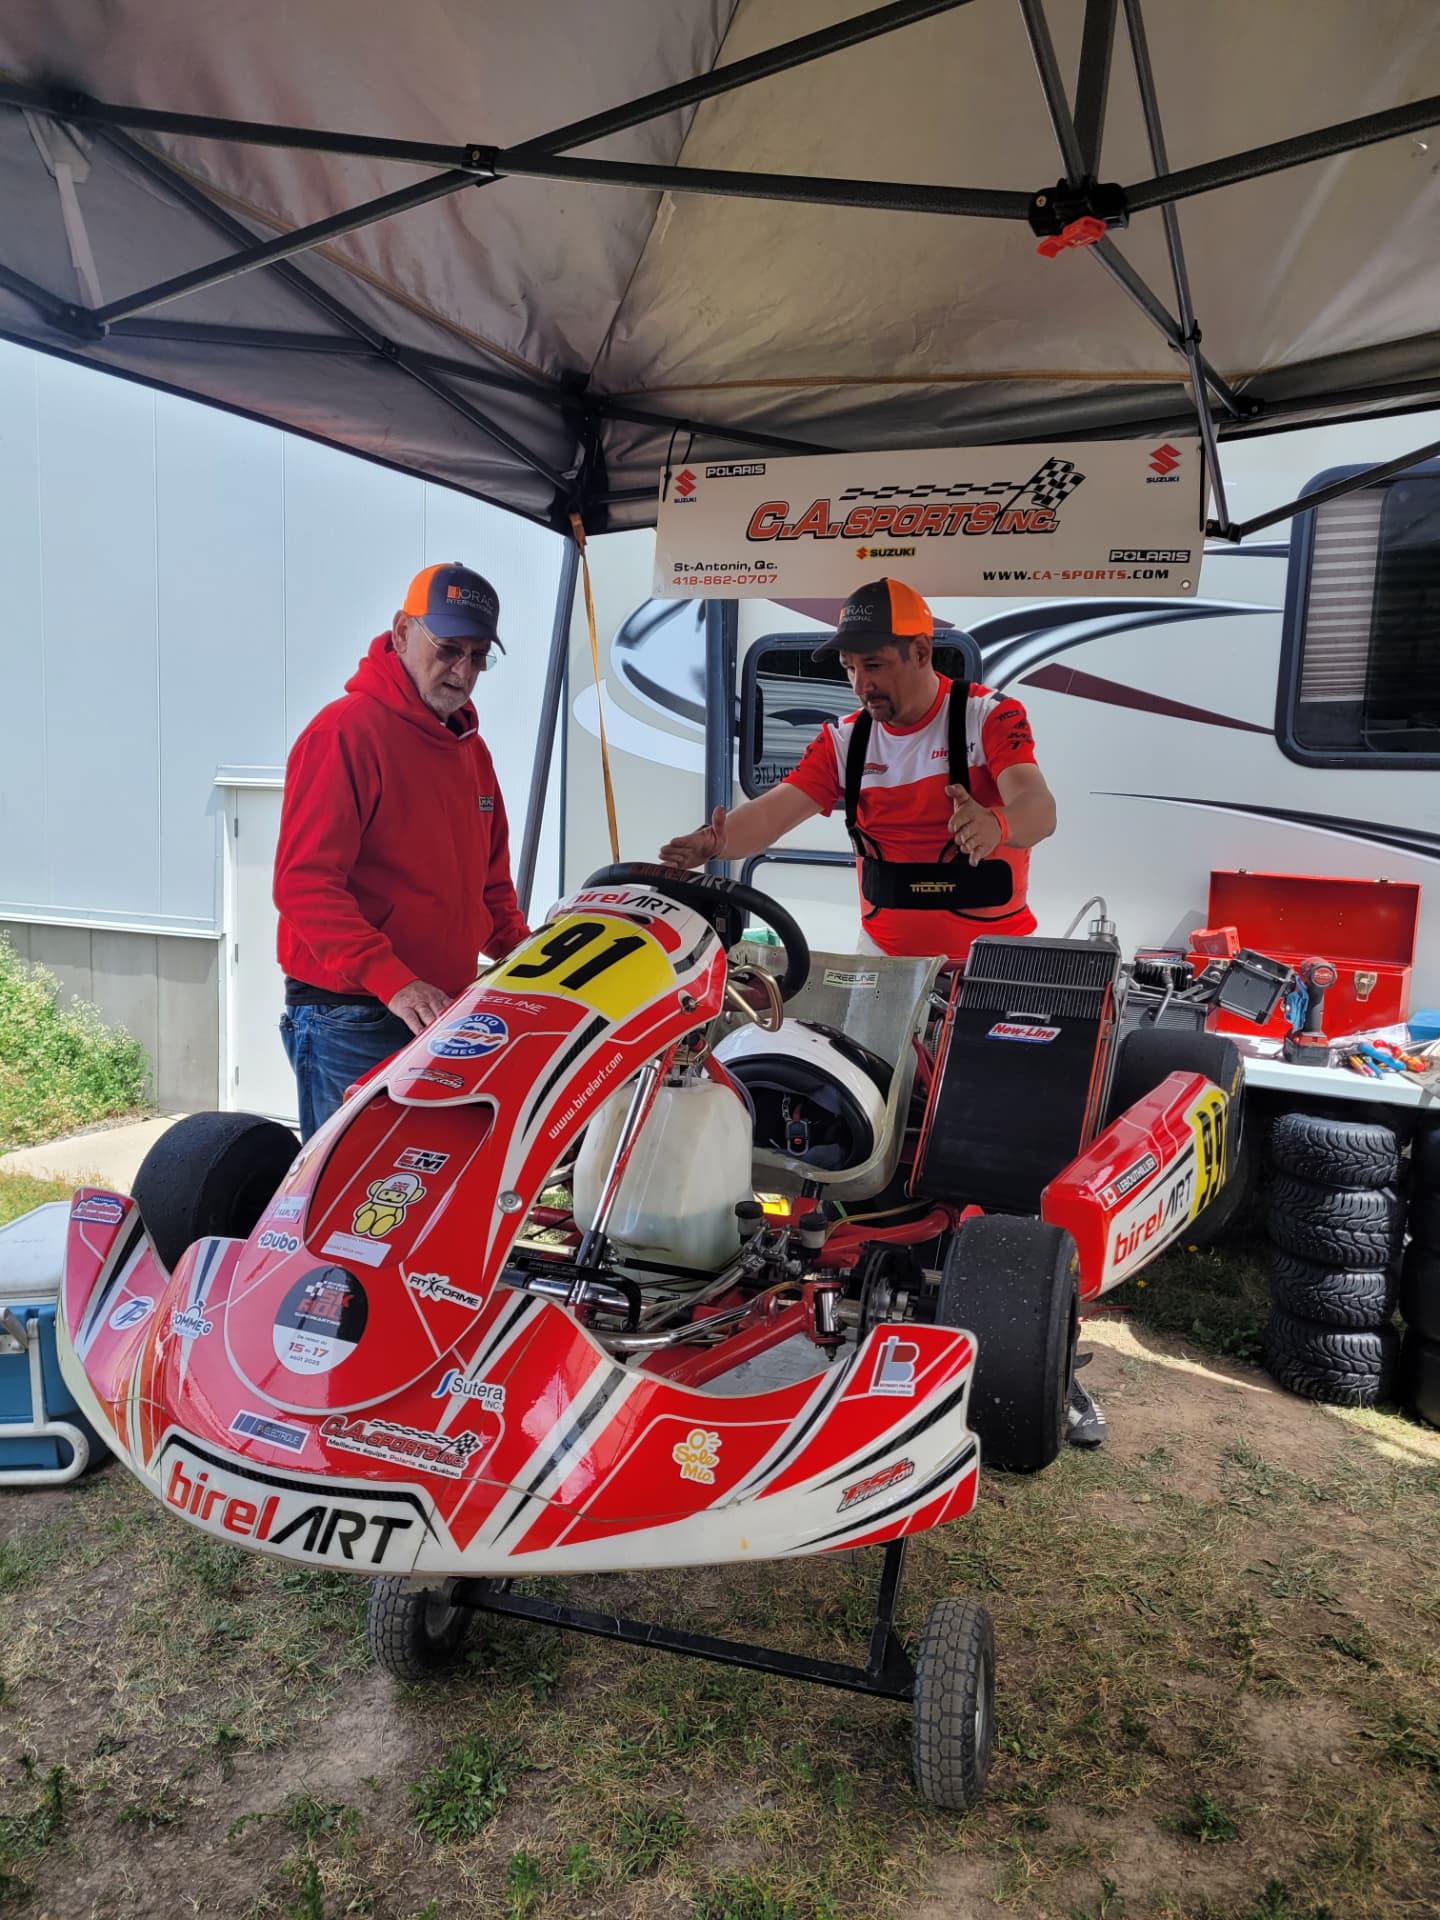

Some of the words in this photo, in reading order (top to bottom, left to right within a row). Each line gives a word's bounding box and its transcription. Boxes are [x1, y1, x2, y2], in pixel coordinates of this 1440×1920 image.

[706, 464, 765, 477] POLARIS
[841, 503, 1000, 538] SPORTS
[992, 508, 1061, 535] INC.
[869, 547, 916, 558] SUZUKI
[1109, 550, 1190, 563] POLARIS
[674, 561, 752, 573] St-Antonin,
[982, 569, 1170, 581] WWW.CA-SPORTS.COM
[672, 574, 778, 586] 418-862-0707
[993, 1024, 1056, 1038] New-Line
[547, 1051, 624, 1140] www.birelart.com
[1112, 1167, 1194, 1266] birelART
[288, 1341, 305, 1353] 15
[312, 1347, 330, 1358] 17
[451, 1377, 503, 1402] Sutera
[367, 1430, 443, 1461] SPORTS
[674, 1444, 718, 1466] Sole
[166, 1460, 414, 1565] birelART
